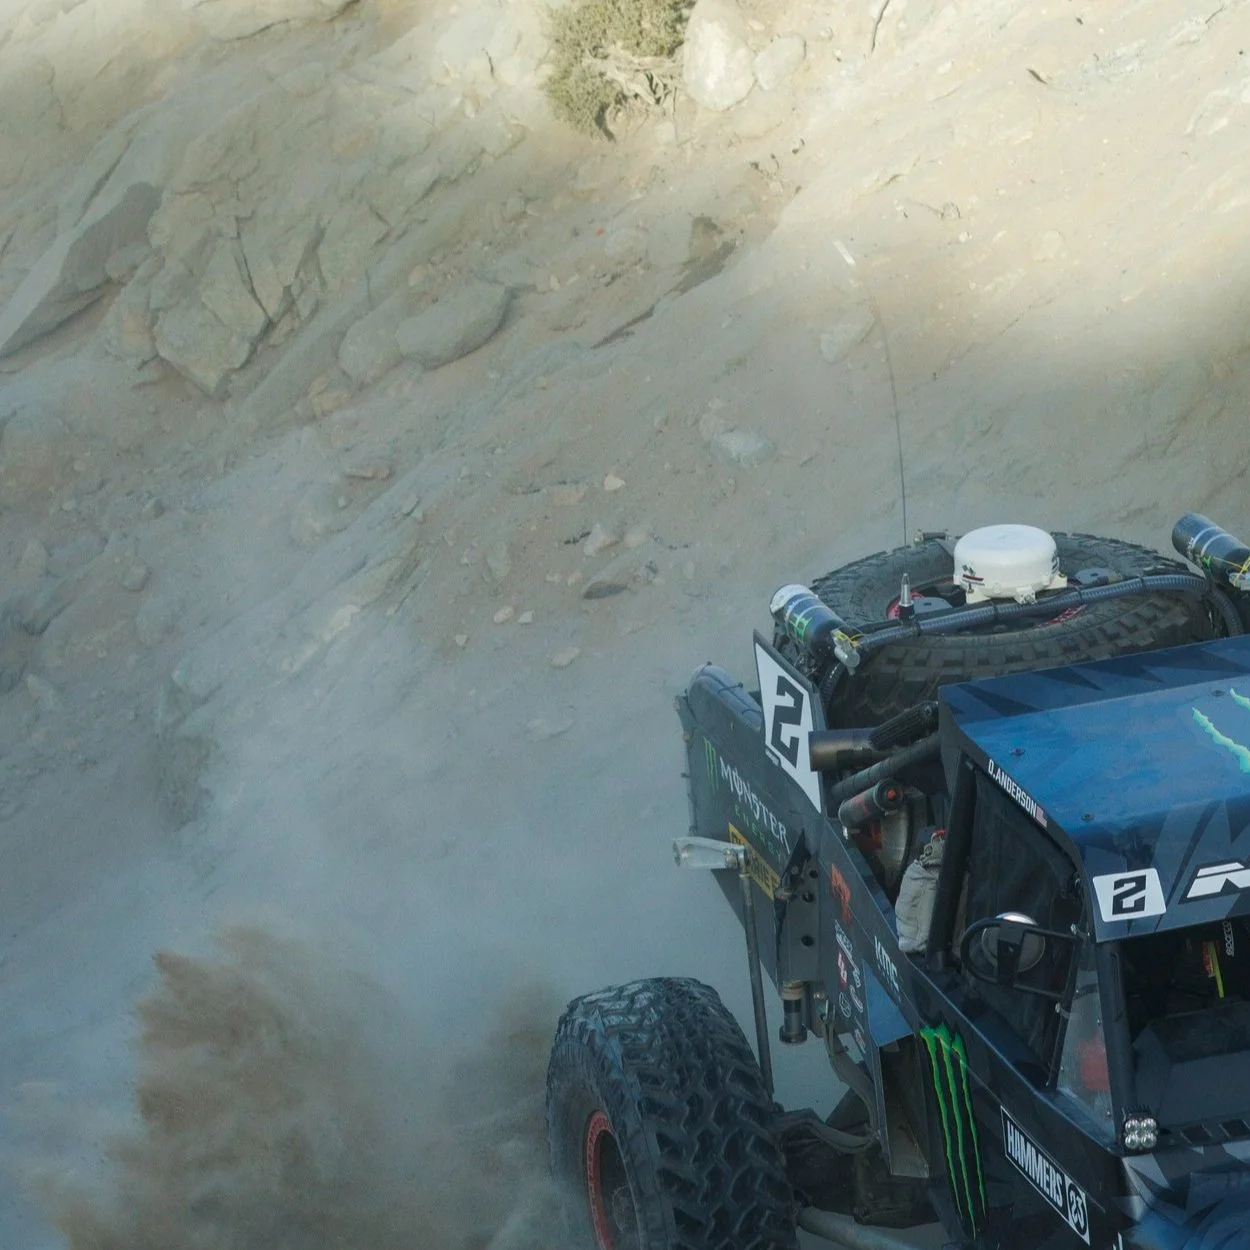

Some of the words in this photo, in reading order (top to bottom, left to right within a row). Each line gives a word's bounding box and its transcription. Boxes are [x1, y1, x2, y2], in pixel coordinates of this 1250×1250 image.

[770, 675, 804, 769] 2
[988, 759, 1037, 818] D.ANDERSON
[1112, 875, 1146, 915] 2
[1006, 1120, 1064, 1208] HAMMERS
